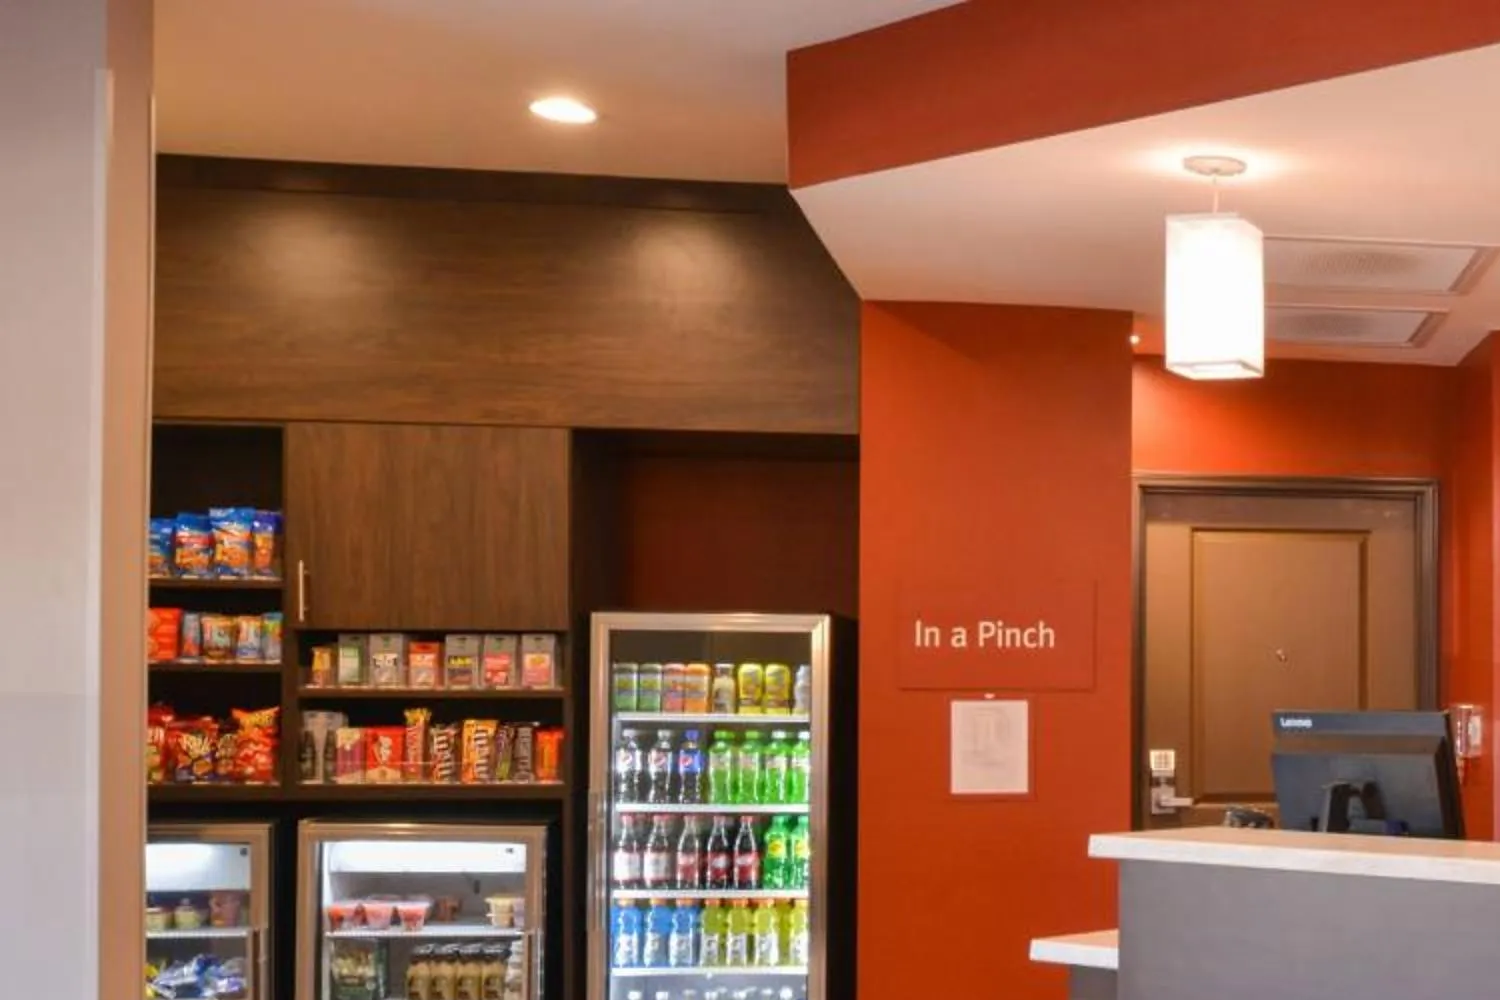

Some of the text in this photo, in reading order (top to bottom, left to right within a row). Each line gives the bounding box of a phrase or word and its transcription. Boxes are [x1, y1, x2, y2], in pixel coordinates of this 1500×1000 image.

[914, 619, 1056, 649] In a Pinch
